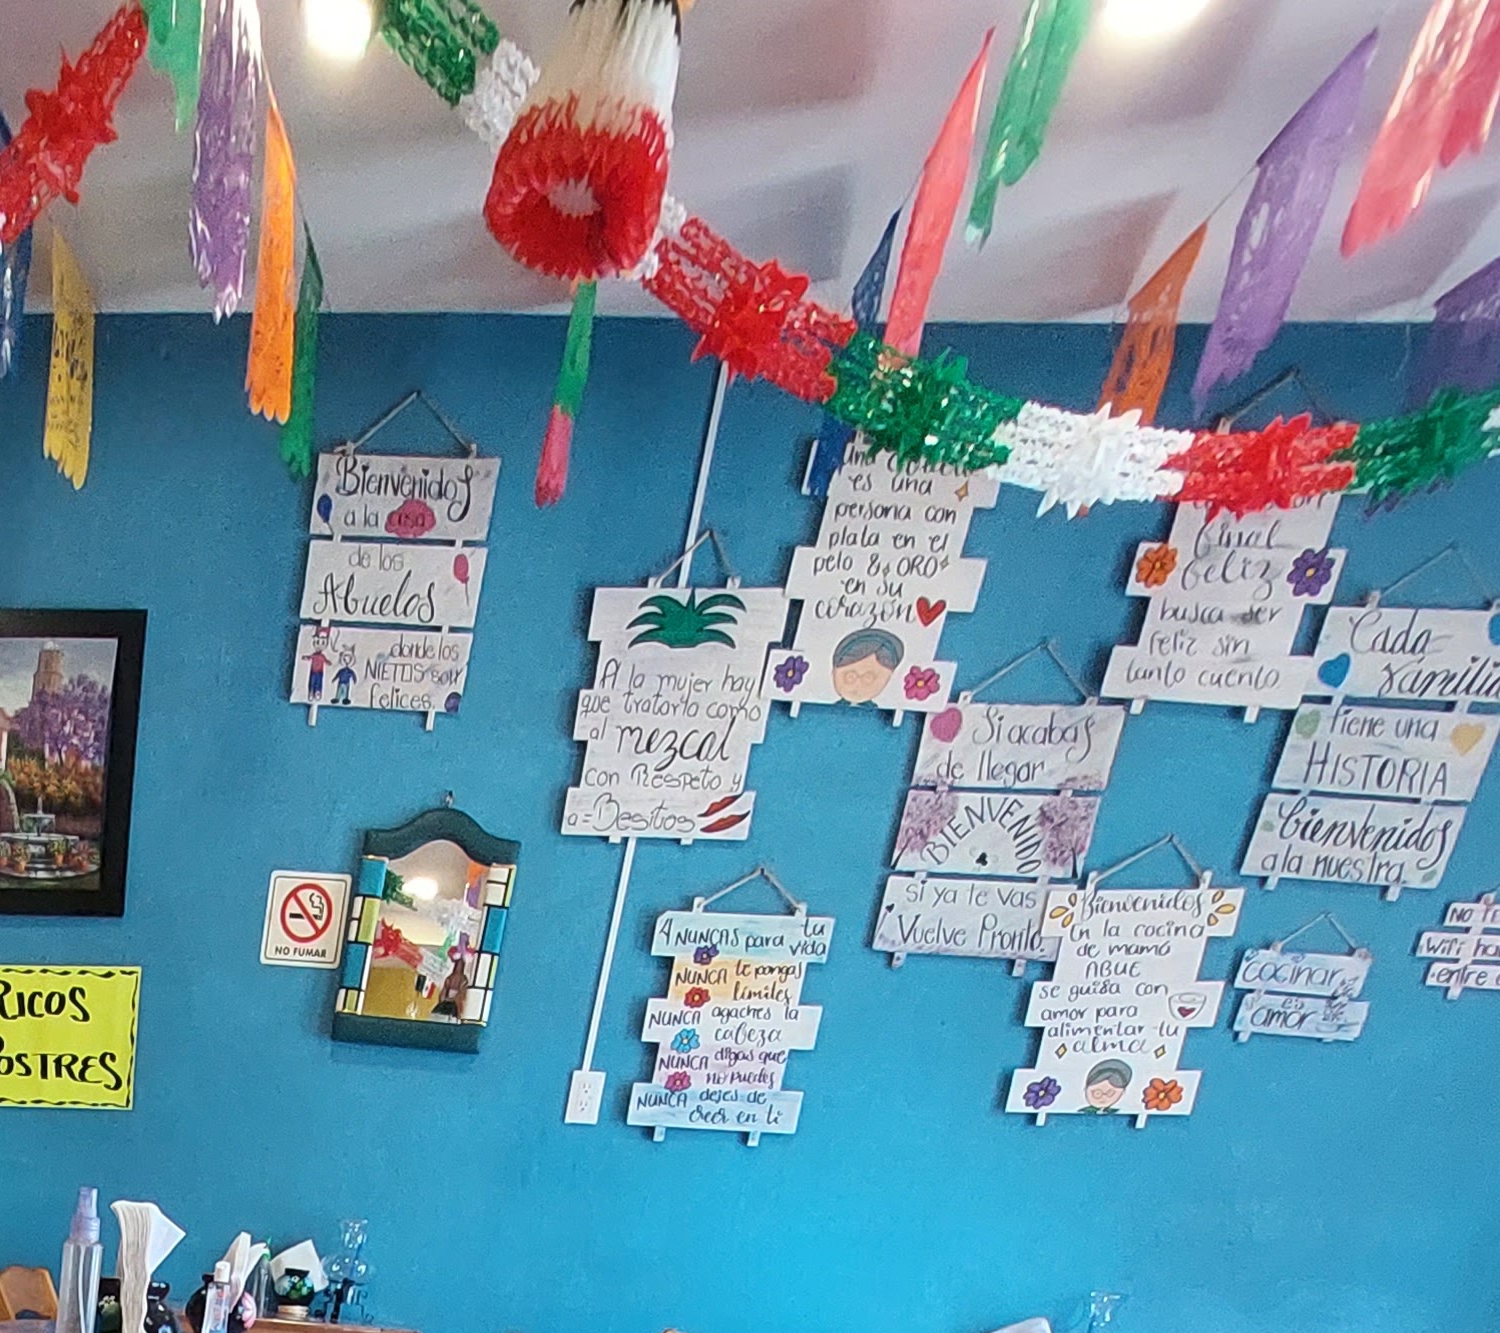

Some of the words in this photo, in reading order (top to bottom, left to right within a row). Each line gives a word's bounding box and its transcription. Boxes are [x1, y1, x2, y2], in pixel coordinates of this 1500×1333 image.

[335, 454, 473, 522] Bienvenidos
[847, 472, 873, 492] es
[890, 476, 933, 496] una
[343, 510, 356, 527] a
[363, 503, 380, 528] la
[834, 500, 912, 521] persona
[924, 506, 958, 525] con
[828, 525, 880, 550] plata
[892, 534, 916, 550] en
[928, 532, 950, 552] el
[348, 545, 371, 569] de
[379, 543, 405, 571] los
[813, 551, 854, 576] pelo
[896, 556, 938, 579] ORO
[313, 570, 436, 623] Abuelos
[840, 577, 866, 596] en
[876, 580, 904, 597] su
[1159, 597, 1224, 623] busca
[1242, 605, 1284, 622] ser
[1349, 608, 1432, 656] Cada
[390, 634, 436, 659] donde
[438, 636, 460, 660] los
[1211, 634, 1251, 657] sin
[364, 659, 426, 684] NIETOS
[601, 657, 622, 690] A
[630, 664, 646, 690] la
[657, 672, 713, 698] mujer
[721, 664, 756, 706] hay
[1126, 659, 1187, 688] tanto
[580, 694, 611, 718] que
[705, 702, 762, 722] como
[971, 705, 1005, 746] Si
[1007, 710, 1096, 764] acabas
[1394, 718, 1440, 740] una
[589, 717, 608, 741] al
[614, 715, 737, 772] mezcal
[584, 767, 620, 787] con
[731, 773, 744, 794] y
[936, 750, 966, 781] de
[977, 749, 1046, 788] llegar
[1303, 741, 1448, 796] HISTORIA
[920, 795, 1043, 875] BIENVENIDO
[1261, 852, 1277, 871] a
[1281, 843, 1303, 874] la
[931, 883, 958, 909] ya
[968, 883, 989, 906] te
[1080, 890, 1203, 921] Bienvenidos
[1449, 907, 1475, 923] NO
[674, 927, 740, 947] NUNCAS
[745, 932, 785, 952] para
[800, 917, 826, 936] tu
[897, 913, 967, 947] Vuelve
[1102, 919, 1120, 938] la
[1133, 919, 1206, 939] cocina
[274, 945, 292, 956] NO
[293, 946, 328, 959] FUMAR
[789, 939, 827, 957] vida
[1076, 942, 1101, 957] de
[674, 967, 728, 986] NUNCA
[733, 958, 752, 976] te
[753, 961, 803, 984] pongas
[1084, 960, 1142, 979] ABUE
[1038, 984, 1061, 1000] se
[1134, 982, 1169, 996] con
[648, 1009, 701, 1029] NUNCA
[711, 1005, 772, 1024] agaches
[784, 1005, 799, 1021] la
[1040, 1007, 1088, 1022] amor
[1095, 1006, 1139, 1023] para
[1249, 1007, 1317, 1034] amor
[714, 1022, 783, 1048] cabeza
[1047, 1022, 1146, 1038] alimentar
[1152, 1020, 1180, 1037] tu
[1072, 1038, 1150, 1055] alma
[658, 1054, 709, 1071] NUNCA
[757, 1049, 787, 1066] que
[636, 1092, 689, 1111] NUNCA
[699, 1087, 740, 1102] dejes
[746, 1089, 768, 1105] de
[737, 1109, 758, 1124] en
